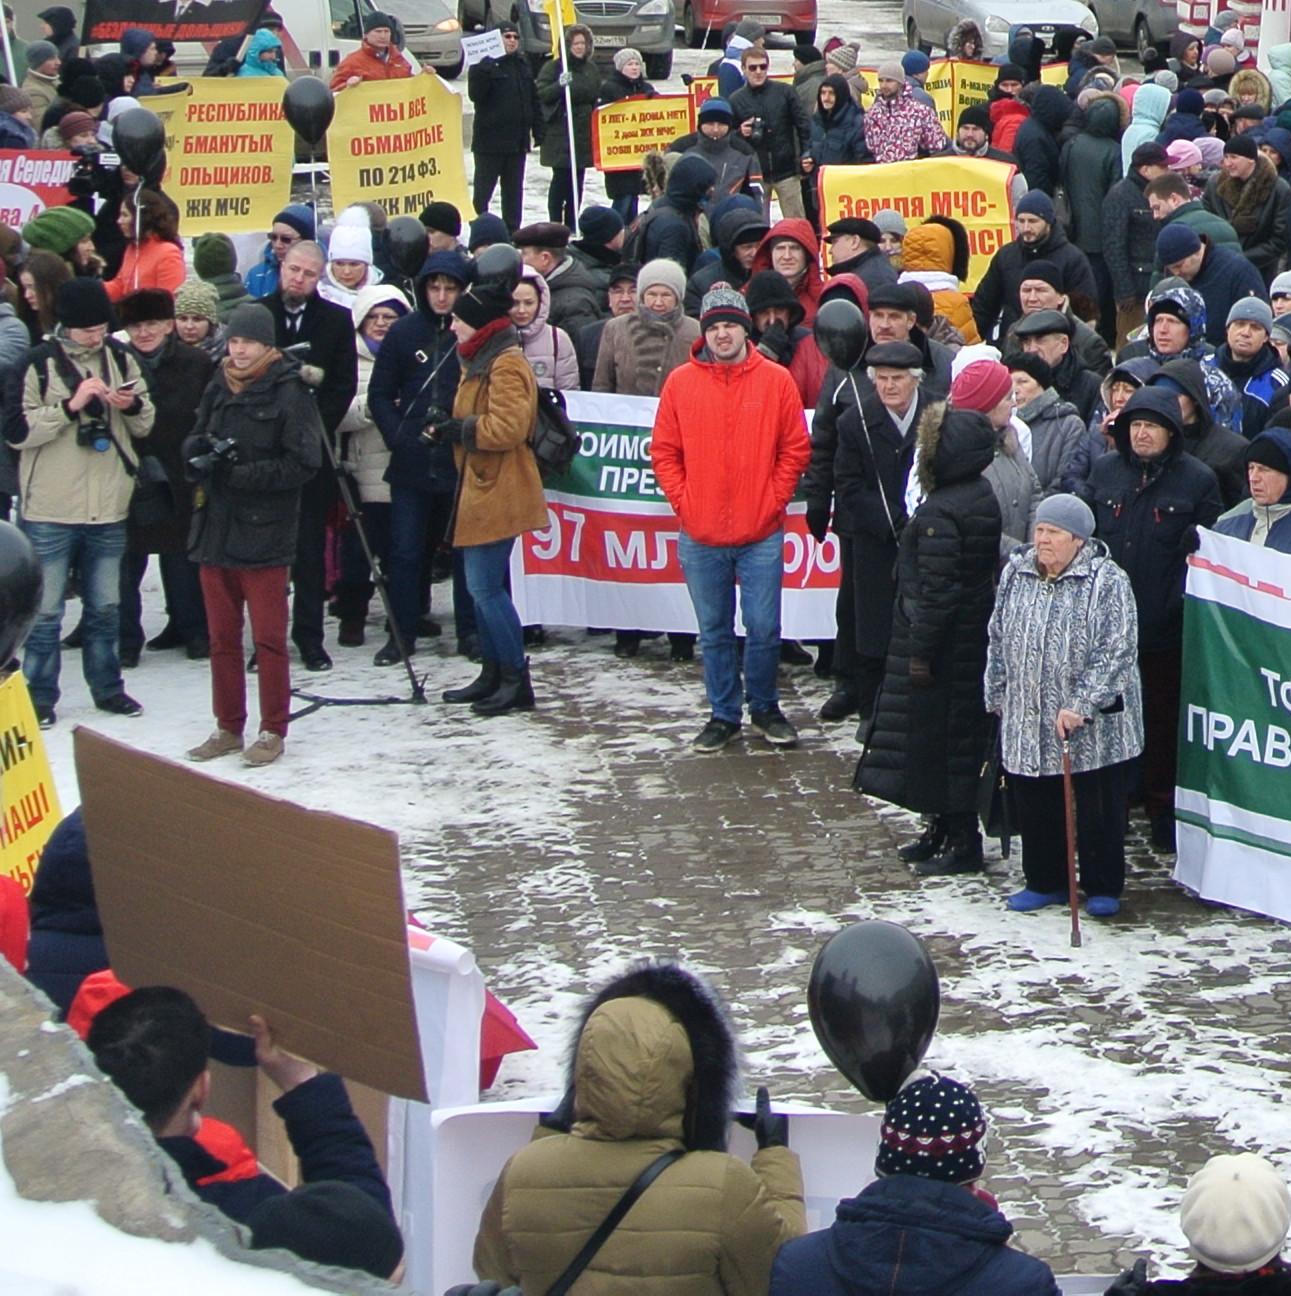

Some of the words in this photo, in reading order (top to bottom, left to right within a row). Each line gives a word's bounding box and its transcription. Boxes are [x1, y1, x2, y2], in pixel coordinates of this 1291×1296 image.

[369, 102, 404, 123] МЫ
[408, 96, 427, 120] ВСЕ
[631, 112, 637, 123] А
[183, 134, 273, 154] БМАНУТЫХ
[351, 124, 444, 157] ОБМАНУТЫЕ
[614, 130, 620, 139] 2
[13, 155, 76, 187] Середи
[180, 166, 274, 188] ОЛЬЩИКОВ.
[359, 167, 383, 187] ПО
[389, 163, 415, 185] 214
[417, 157, 440, 179] ФЗ.
[186, 199, 212, 218] ЖК
[215, 197, 250, 217] МЧС
[931, 191, 996, 217] МЧС-
[600, 466, 665, 497] ПРЕ
[531, 507, 586, 562] 97
[604, 531, 681, 570] МЛ
